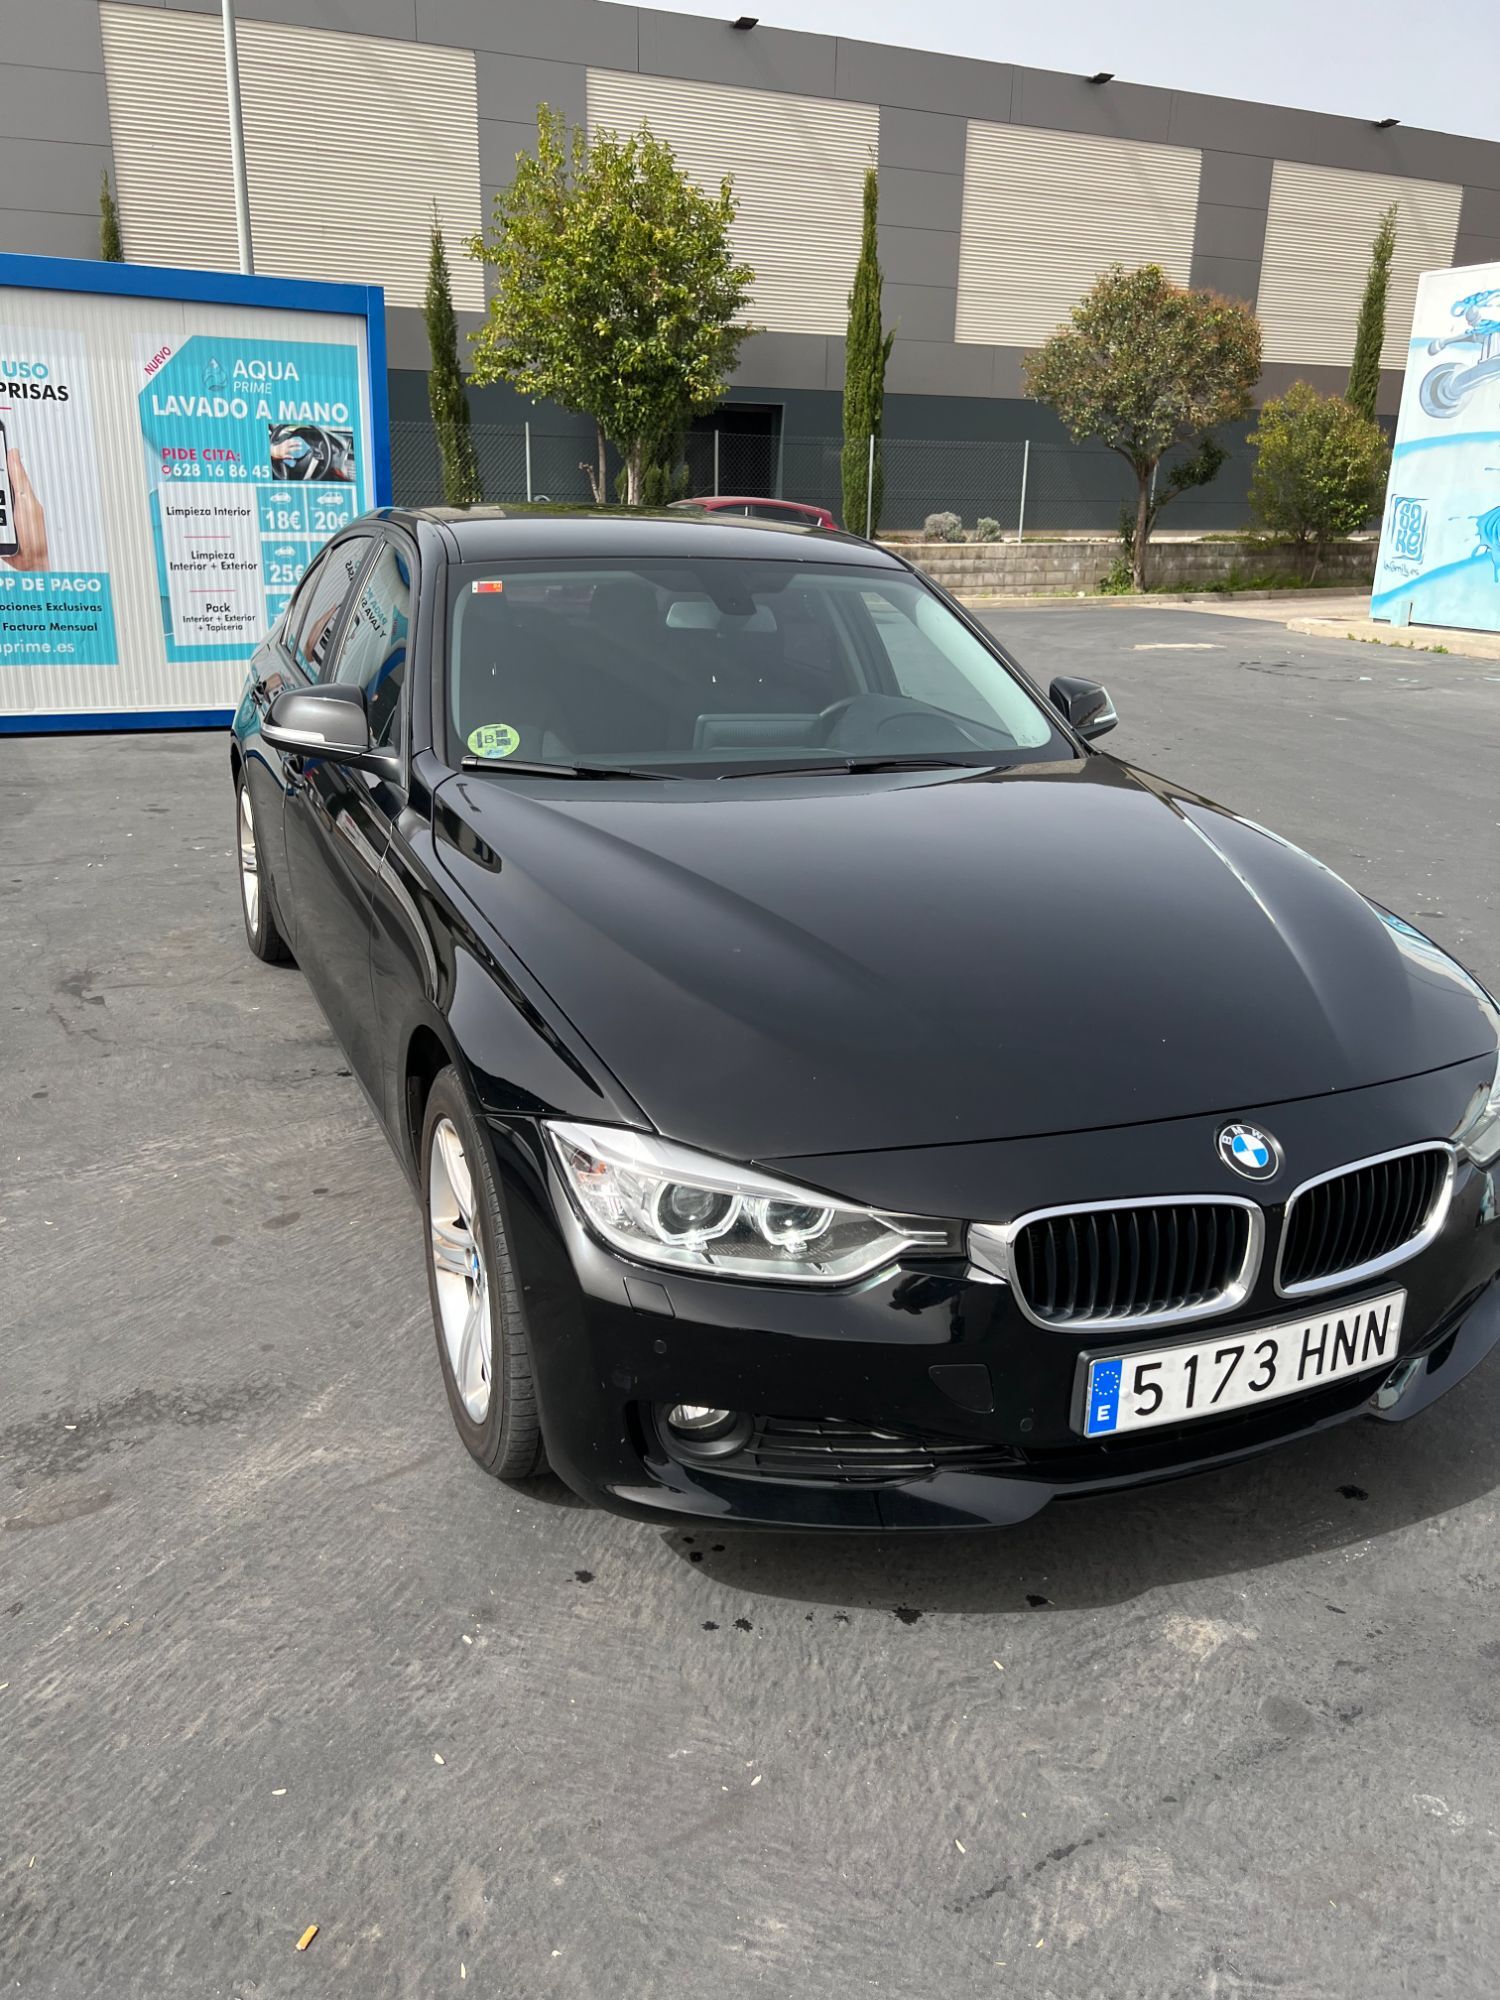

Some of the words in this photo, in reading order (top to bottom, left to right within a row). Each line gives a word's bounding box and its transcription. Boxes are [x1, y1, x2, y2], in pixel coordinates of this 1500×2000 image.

[144, 346, 172, 376] NUEVO
[2, 360, 49, 379] USO
[233, 359, 300, 382] AQUA
[233, 381, 273, 395] PRIME
[152, 394, 249, 420] LAVADO
[256, 399, 273, 420] A
[278, 400, 350, 423] MANO
[161, 447, 198, 461] PIDE
[202, 448, 241, 462] CITA:
[173, 463, 201, 477] 628
[207, 464, 225, 478] 16
[229, 464, 248, 478] 86
[252, 465, 271, 479] 45
[166, 506, 212, 518] Limpieza
[214, 506, 251, 517] Interior
[265, 510, 301, 530] 18€
[314, 510, 349, 531] 20€
[191, 550, 235, 562] Limpieza
[169, 561, 207, 571] Interior
[211, 563, 218, 571] +
[221, 561, 259, 571] Exterior
[269, 563, 305, 583] 25€
[21, 577, 46, 592] DE
[51, 577, 102, 592] PAGO
[46, 602, 103, 613] Exclusivas
[206, 602, 231, 614] Pack
[3, 622, 47, 632] Factura
[49, 622, 99, 632] Mensual
[182, 615, 214, 624] Interior
[224, 614, 256, 623] Exterior
[0, 639, 76, 656] prime.es
[1221, 1126, 1264, 1146] BMW
[1132, 1338, 1280, 1417] 5173
[1297, 1304, 1392, 1382] HNN
[1096, 1404, 1111, 1422] E
